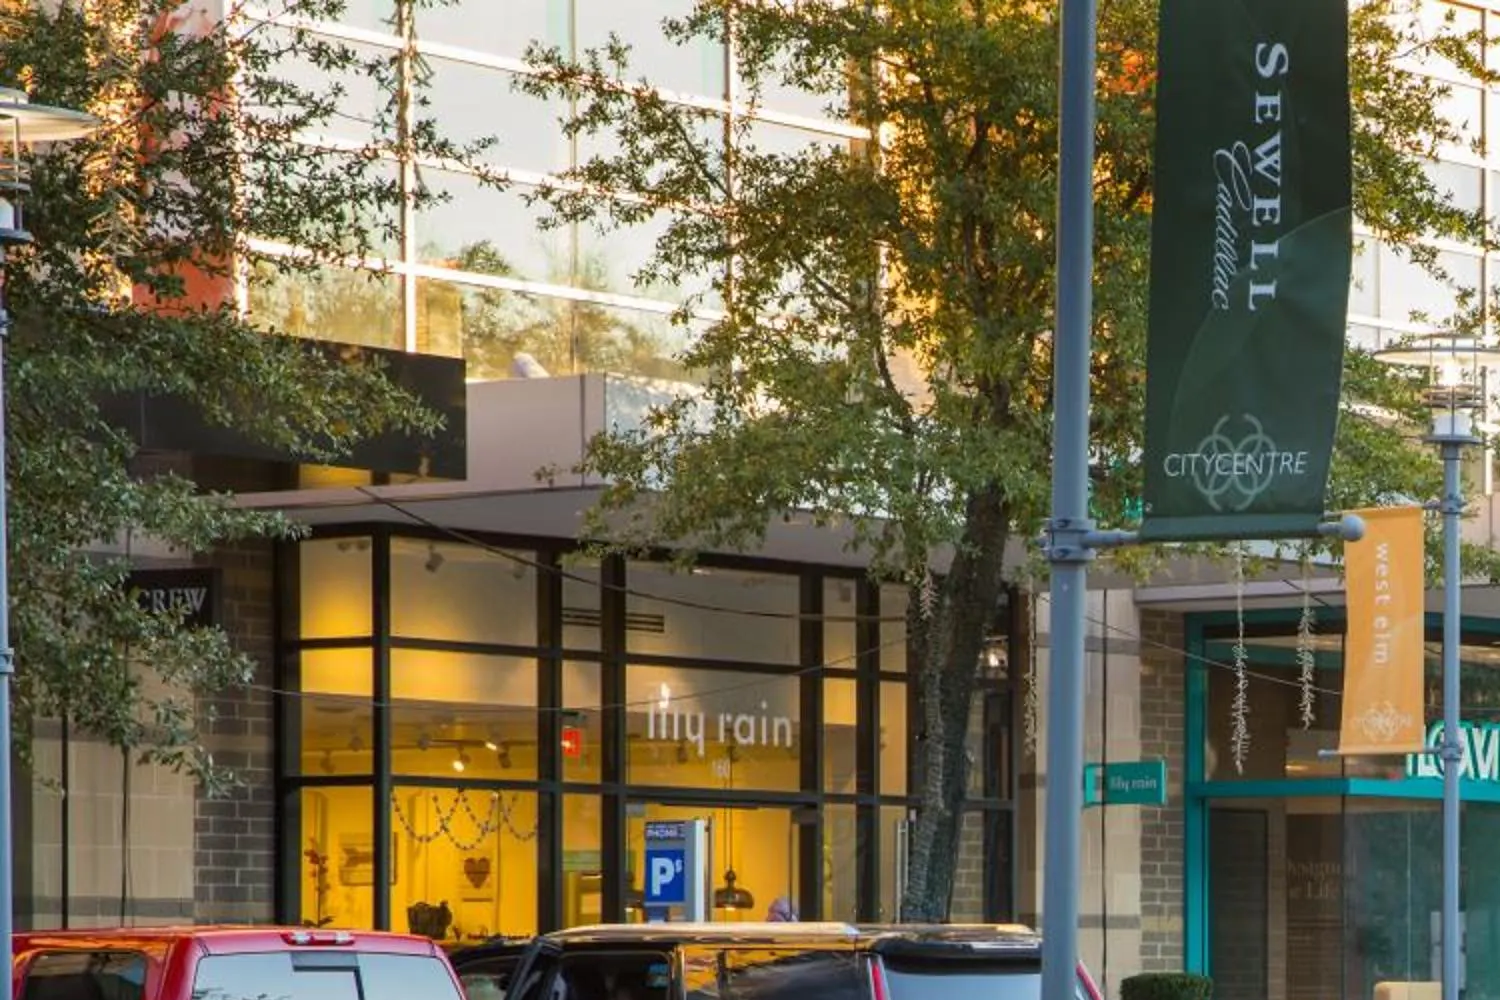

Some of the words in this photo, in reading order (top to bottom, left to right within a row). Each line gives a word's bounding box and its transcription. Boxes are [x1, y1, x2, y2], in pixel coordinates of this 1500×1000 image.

[1248, 42, 1289, 311] SEWELL
[1212, 141, 1252, 310] Cadillac
[1163, 451, 1309, 477] CITYCENTRE
[1375, 542, 1392, 606] west
[1374, 615, 1392, 664] elm
[719, 700, 792, 747] rain
